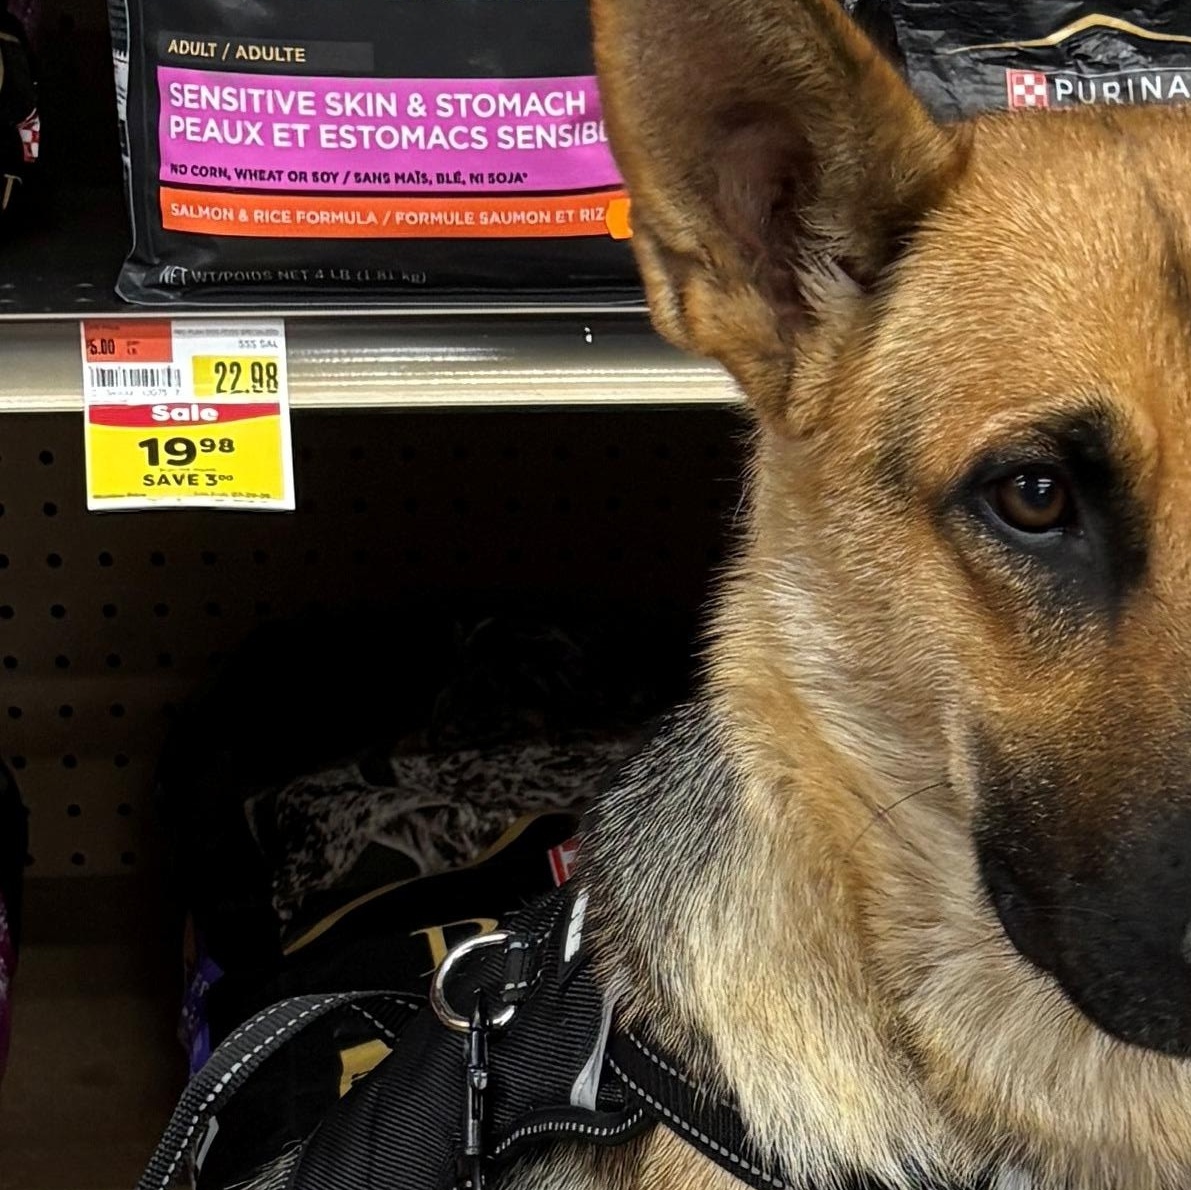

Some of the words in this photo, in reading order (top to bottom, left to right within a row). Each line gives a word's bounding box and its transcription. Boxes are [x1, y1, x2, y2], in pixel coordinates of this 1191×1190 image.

[168, 39, 217, 58] ADULT
[222, 43, 230, 61] /
[235, 45, 306, 63] ADULTE
[169, 82, 317, 116] SENSITIVE
[324, 91, 397, 118] SKIN
[407, 92, 427, 117] &
[436, 90, 586, 118] STOMACH
[1055, 73, 1191, 105] PURINA
[169, 115, 264, 147] PEAUX
[273, 122, 310, 148] ET
[319, 124, 489, 150] ESTOMACS
[497, 120, 610, 149] SENSIBL
[170, 163, 187, 175] NO
[191, 164, 231, 180] CORN,
[234, 167, 284, 182] WHEAT
[287, 170, 308, 183] OR
[312, 171, 339, 184] SOY
[342, 171, 351, 185] /
[353, 172, 391, 185] SANS
[469, 172, 484, 184] NI
[170, 203, 234, 221] SALMON
[238, 209, 248, 222] &
[253, 209, 292, 224] RICE
[296, 210, 378, 225] FORMULA
[383, 210, 391, 226] /
[395, 210, 475, 225] FORMULE
[479, 210, 551, 225] SAUMON
[555, 209, 574, 223] ET
[580, 207, 605, 222] RIZ
[159, 265, 188, 285] NET
[278, 268, 309, 281] NET
[214, 361, 279, 395] 22.98
[152, 403, 219, 422] Sale
[143, 473, 199, 487] SAVE
